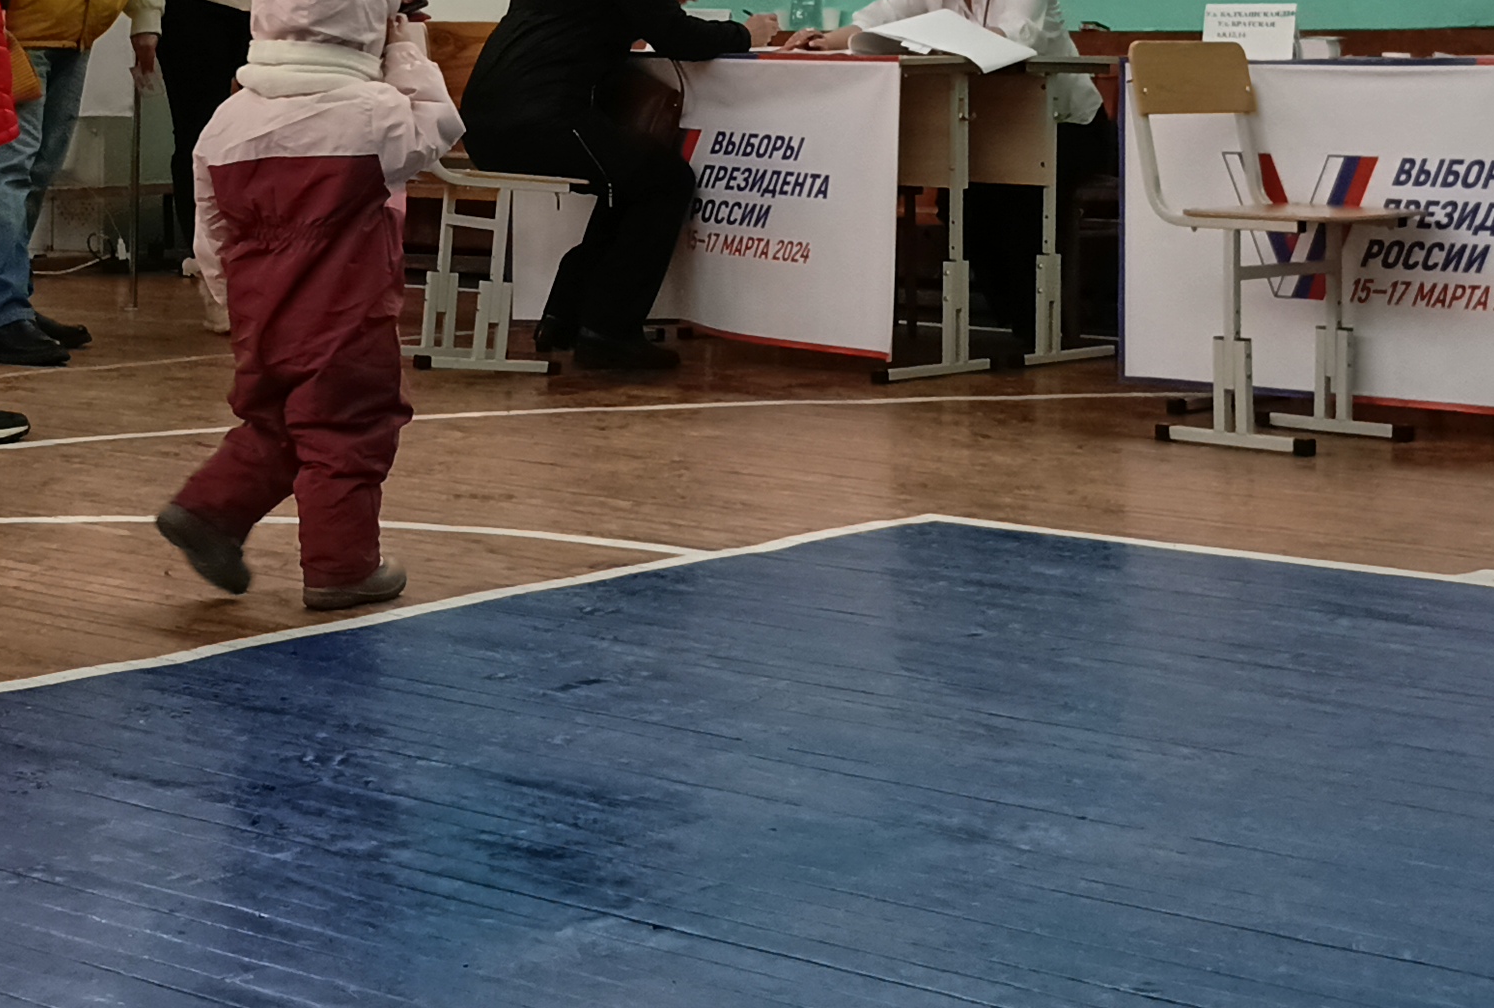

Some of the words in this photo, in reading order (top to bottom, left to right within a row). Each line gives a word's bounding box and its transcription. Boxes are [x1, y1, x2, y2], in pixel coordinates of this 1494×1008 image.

[709, 130, 805, 161] ВЫБОРЫ
[697, 164, 830, 200] ПРЕЗИДЕНТА
[689, 197, 772, 229] РОССИИ
[720, 234, 770, 260] МАРТА
[772, 240, 811, 264] 2024
[1360, 239, 1491, 274] РОССИИ
[1349, 278, 1412, 306] 15–17
[1412, 281, 1491, 311] МАРТА
